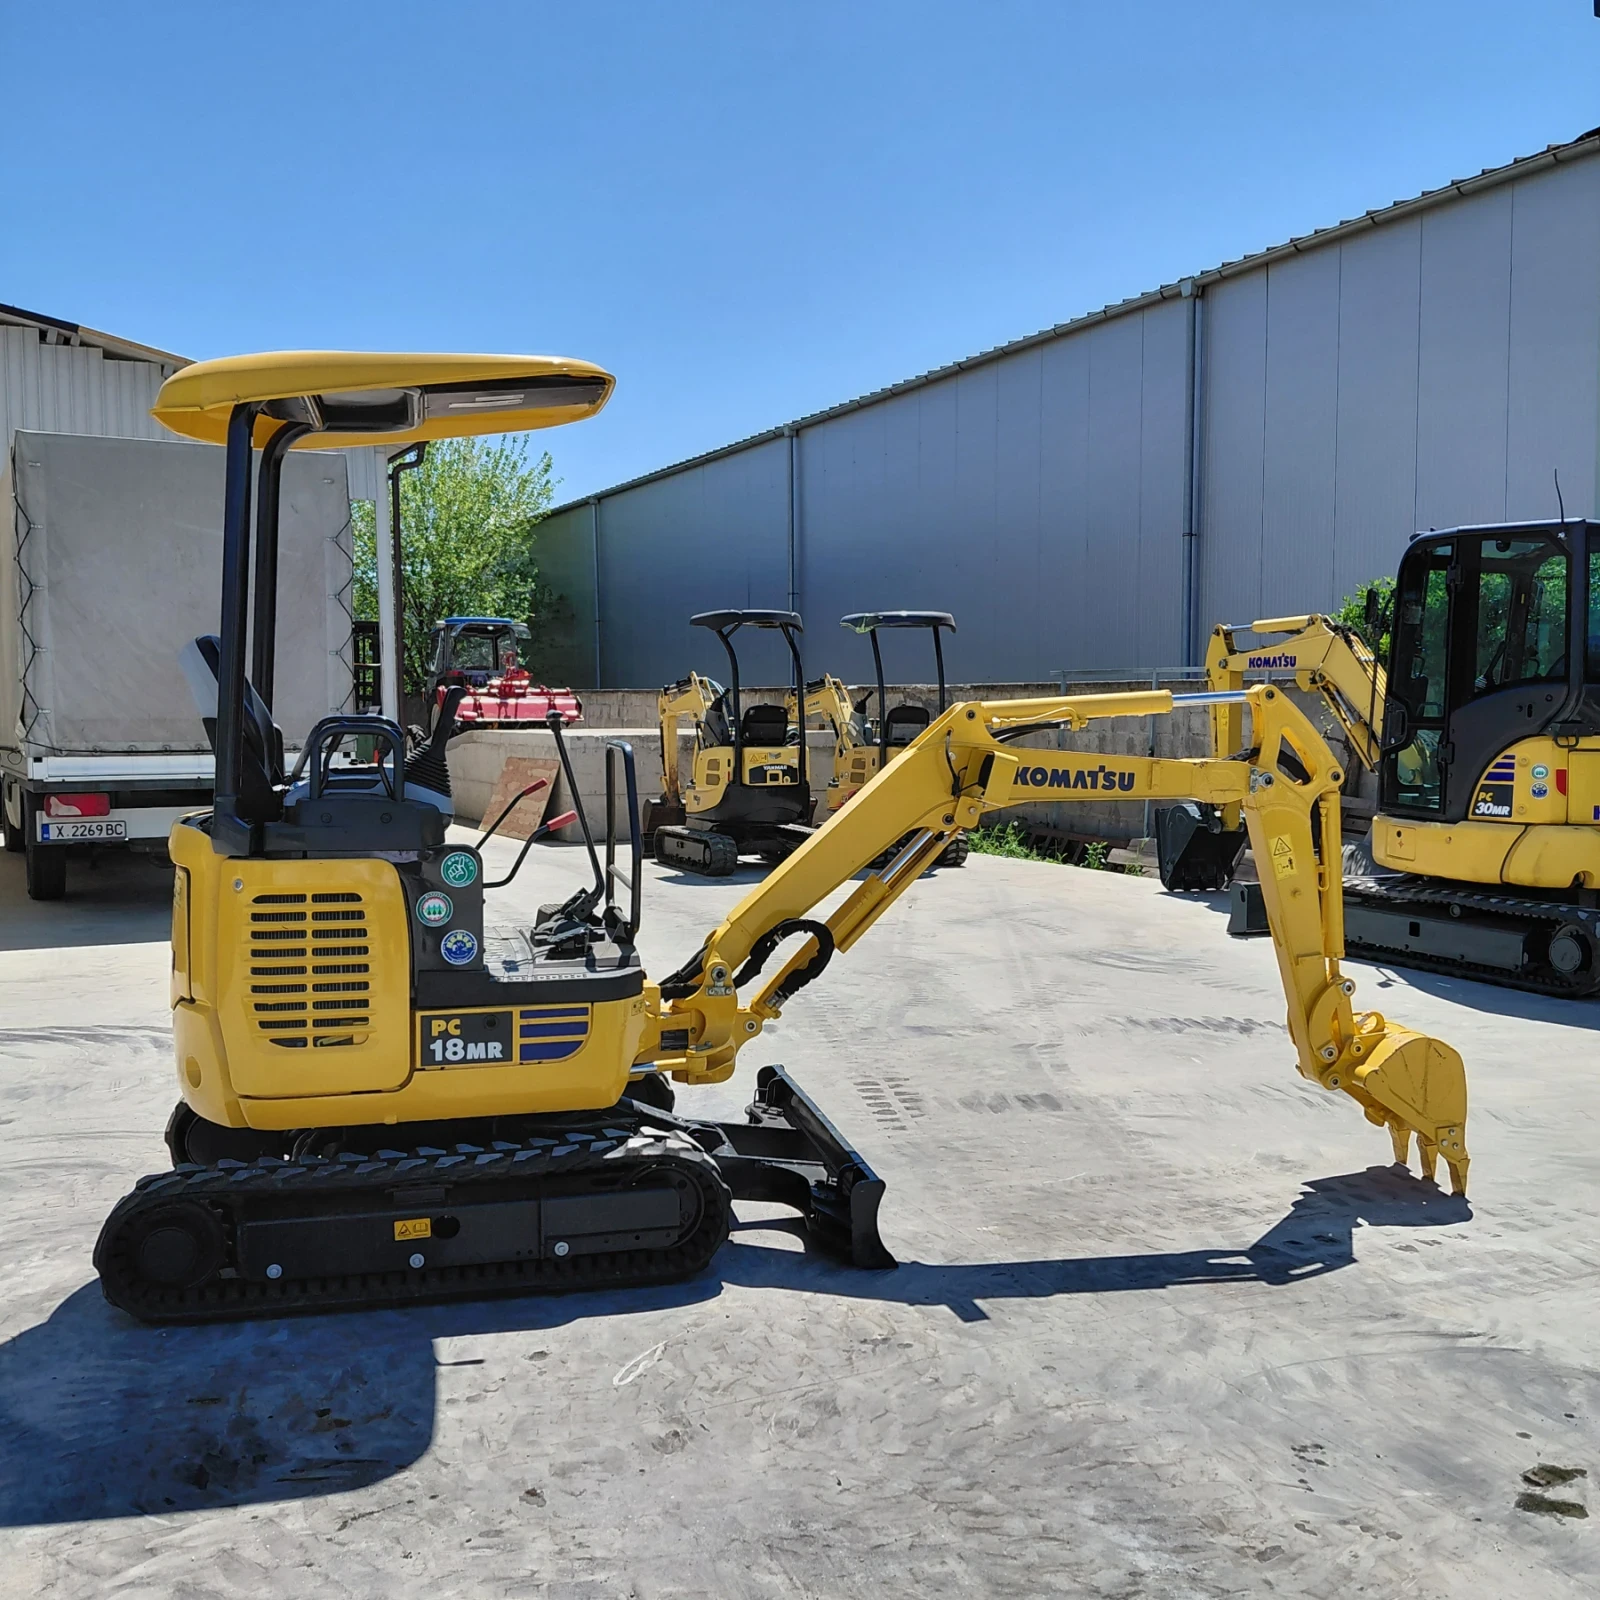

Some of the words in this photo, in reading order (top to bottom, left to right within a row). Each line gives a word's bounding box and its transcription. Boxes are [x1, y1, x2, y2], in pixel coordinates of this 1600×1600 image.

[1249, 652, 1297, 668] KOMATSU
[1013, 765, 1135, 791] KOMATSU
[1478, 792, 1493, 801] PC
[1475, 802, 1510, 815] 30MR
[56, 825, 64, 837] X
[71, 824, 103, 837] 2269
[105, 823, 123, 835] BC
[431, 1019, 461, 1036] PC
[430, 1038, 503, 1061] 18MR
